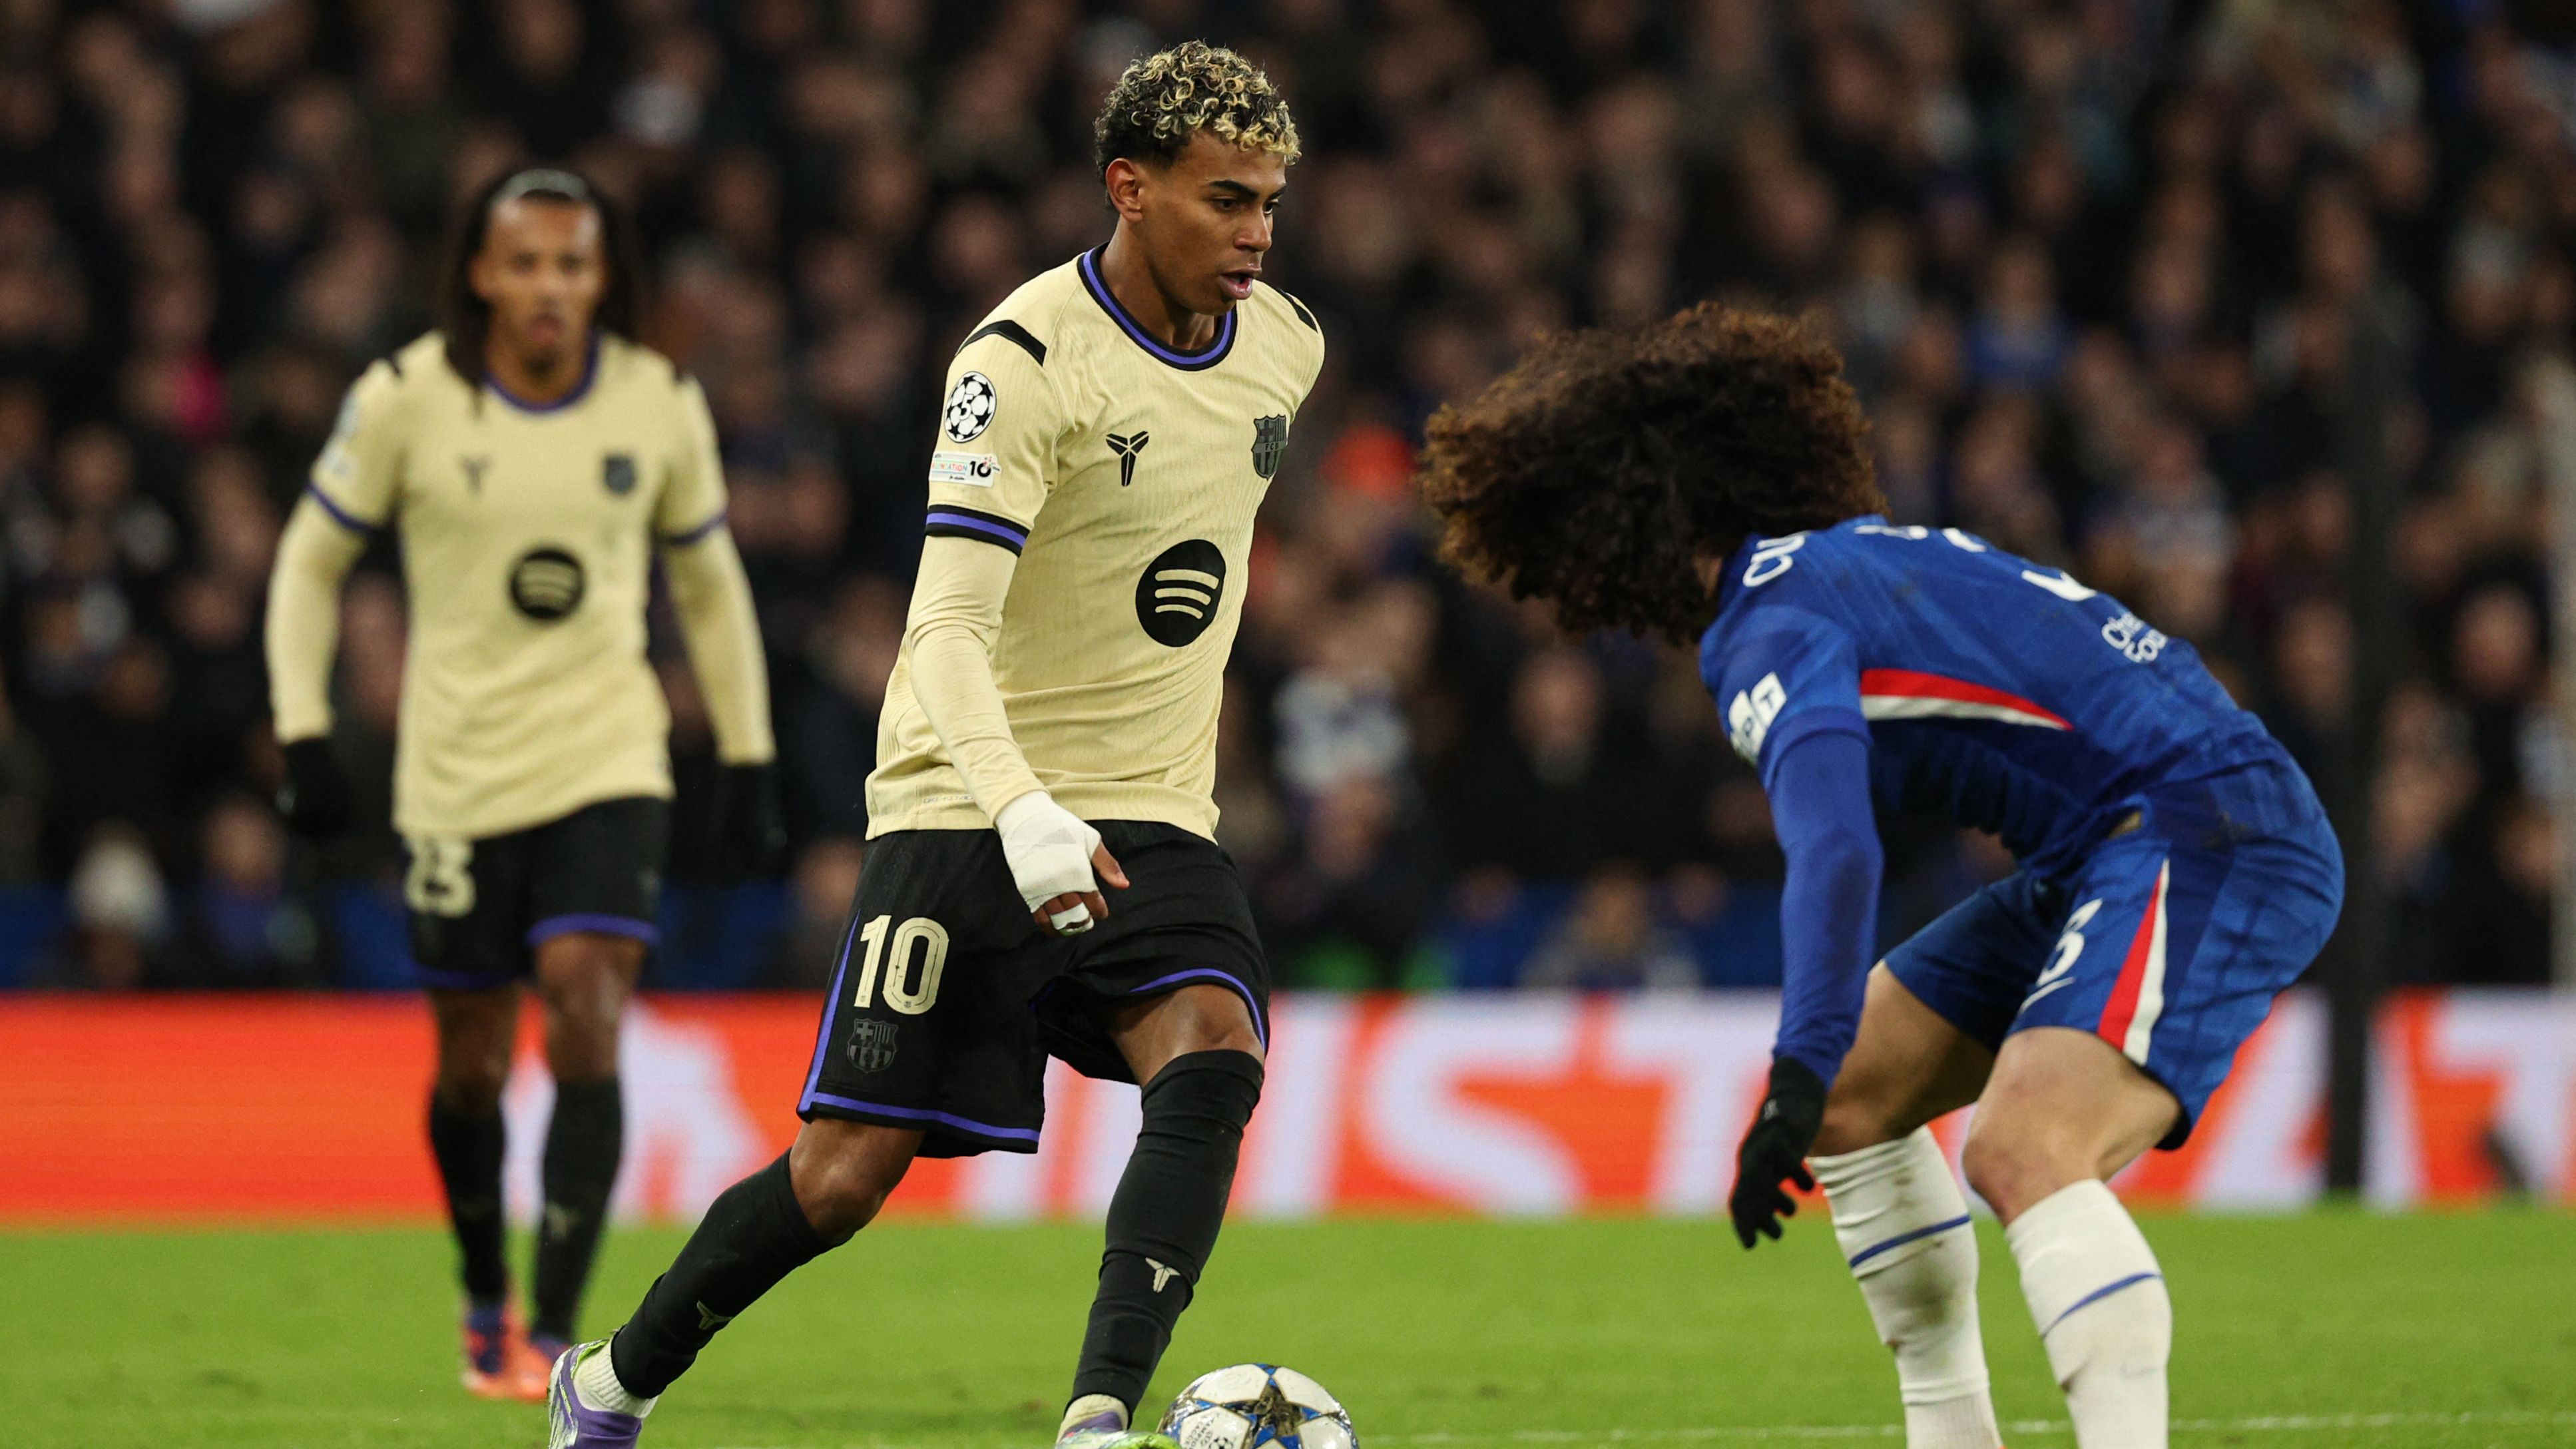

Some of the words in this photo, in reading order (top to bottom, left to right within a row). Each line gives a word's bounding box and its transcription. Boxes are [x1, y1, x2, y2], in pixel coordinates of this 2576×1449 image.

[959, 393, 974, 421] 5
[969, 460, 992, 478] 10
[853, 914, 950, 1015] 10
